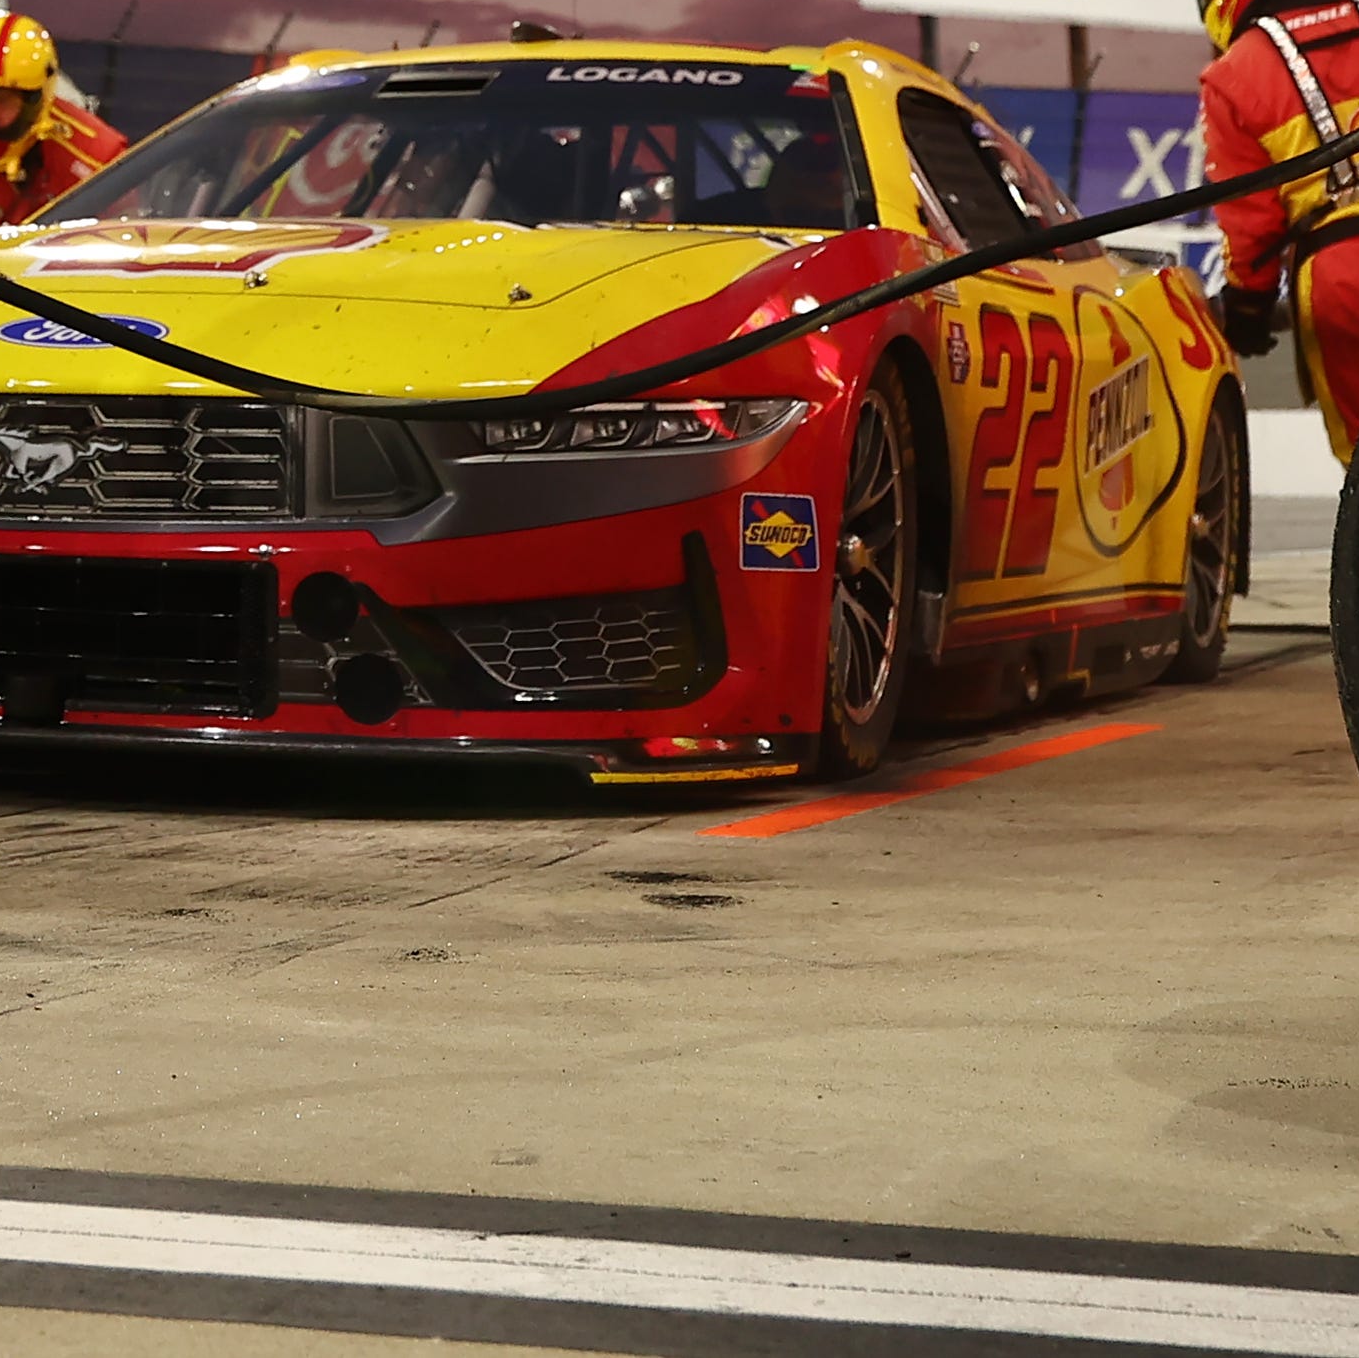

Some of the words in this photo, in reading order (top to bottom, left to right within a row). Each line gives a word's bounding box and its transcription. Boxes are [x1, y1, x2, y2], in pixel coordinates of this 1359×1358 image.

[546, 66, 744, 86] LOGANO
[956, 302, 1074, 582] 22
[747, 525, 809, 545] SUNOCO
